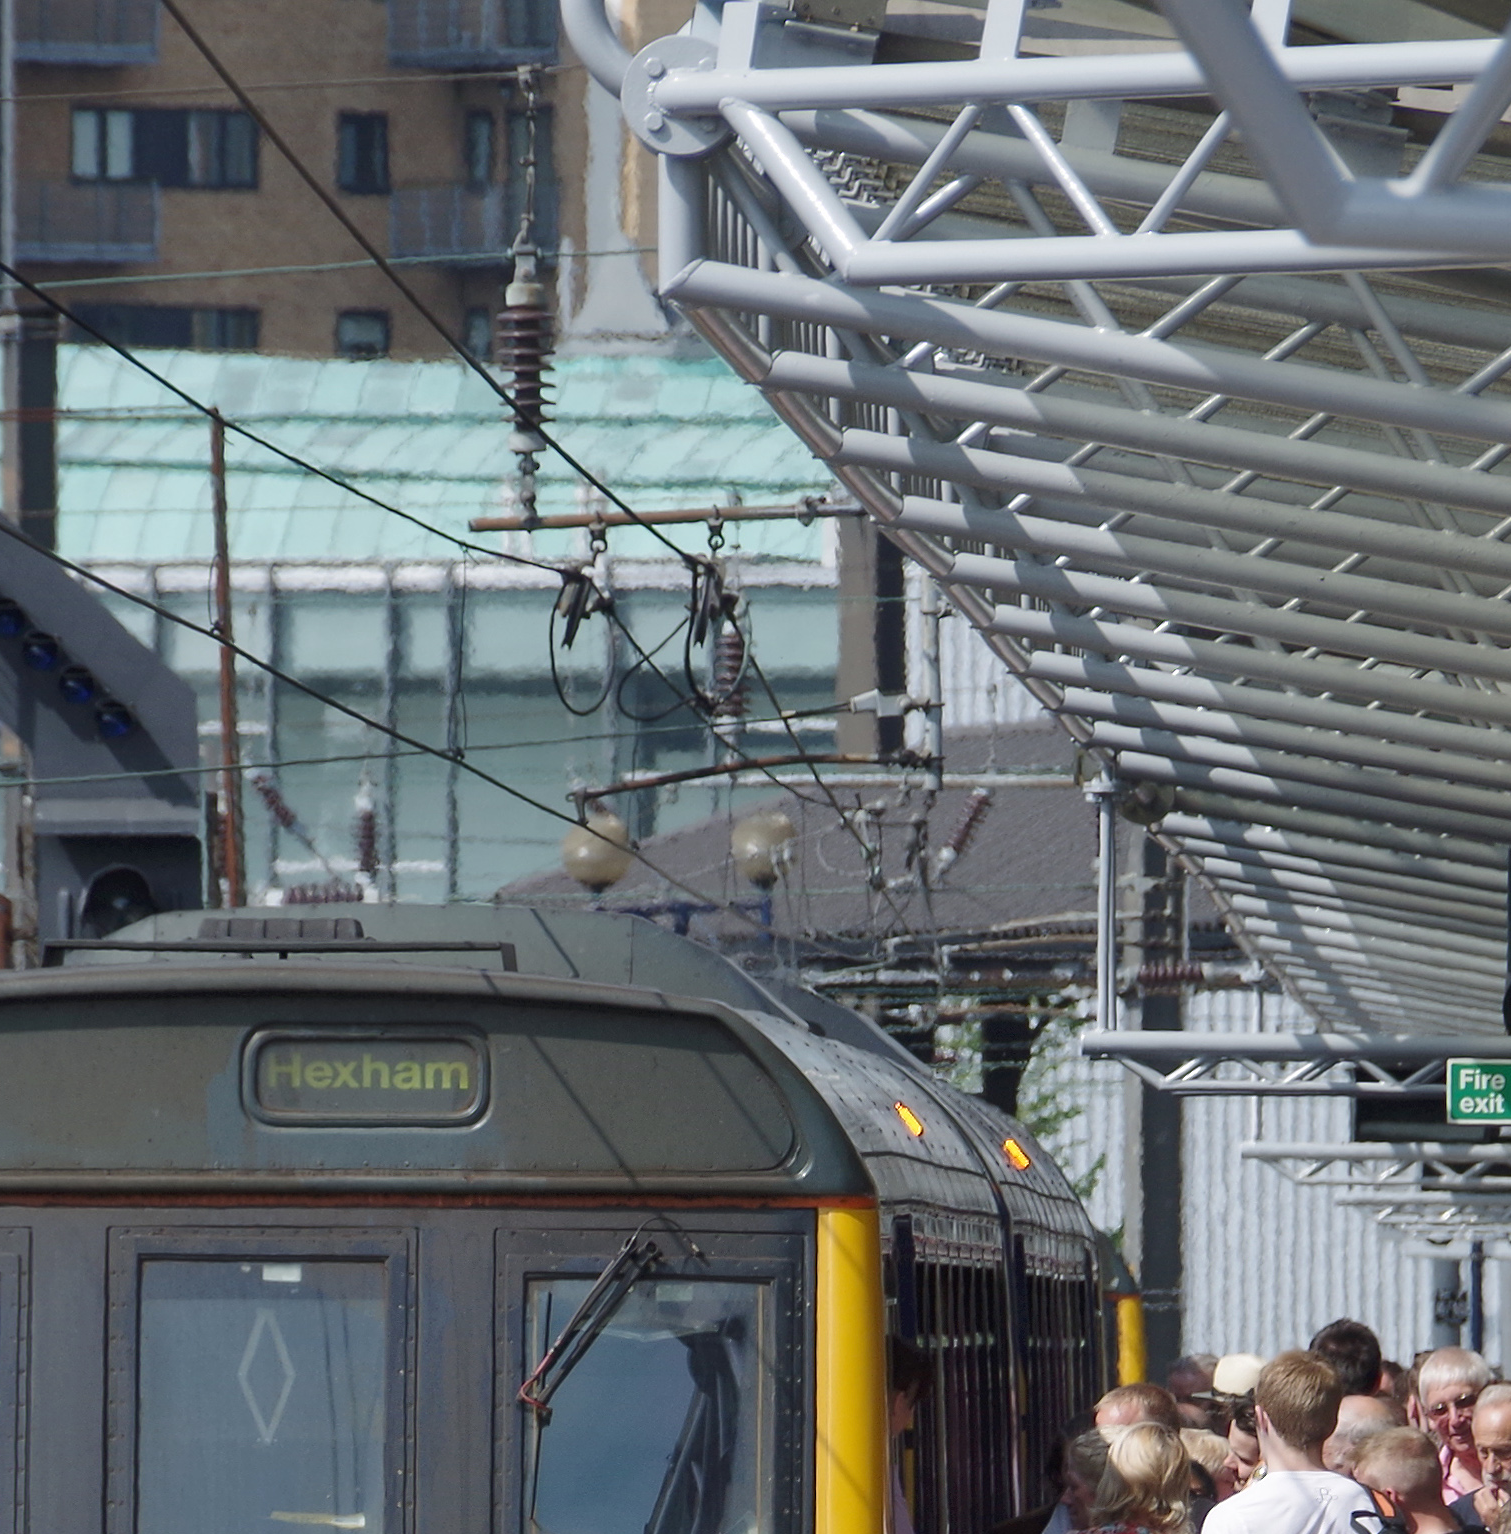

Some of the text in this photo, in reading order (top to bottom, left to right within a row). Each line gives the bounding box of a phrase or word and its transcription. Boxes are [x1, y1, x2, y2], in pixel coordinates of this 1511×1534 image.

[268, 1053, 469, 1090] Hexham
[1459, 1067, 1506, 1091] Fire
[1459, 1092, 1505, 1114] exit
